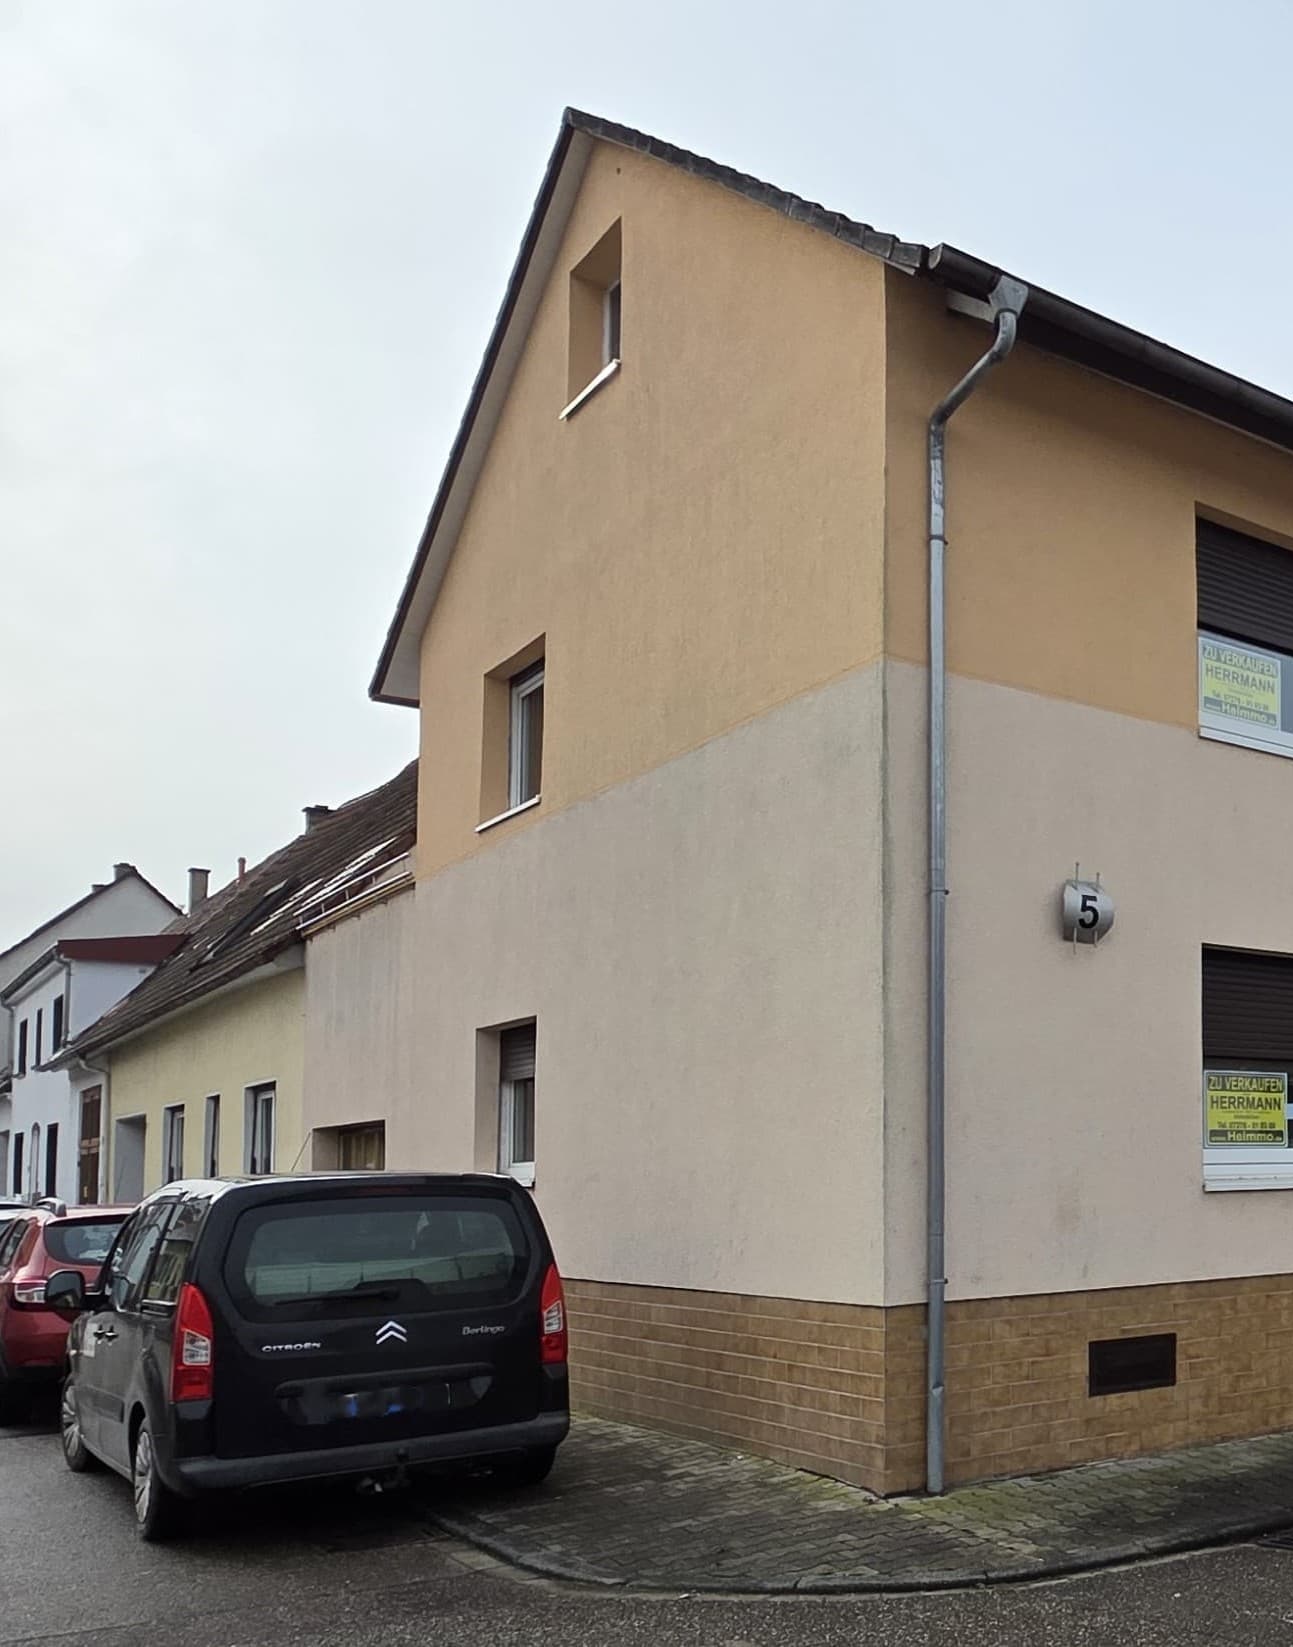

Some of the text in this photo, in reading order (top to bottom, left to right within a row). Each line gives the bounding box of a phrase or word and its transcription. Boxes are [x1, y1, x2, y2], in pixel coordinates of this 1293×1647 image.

[1203, 645, 1278, 677] ZU VERKAUFEN
[1205, 663, 1275, 694] HERRMANN
[1078, 894, 1099, 929] 5
[1208, 1076, 1283, 1092] ZU VERKAUFEN
[1210, 1095, 1282, 1111] HERRMANN
[462, 1324, 506, 1336] Berlingo
